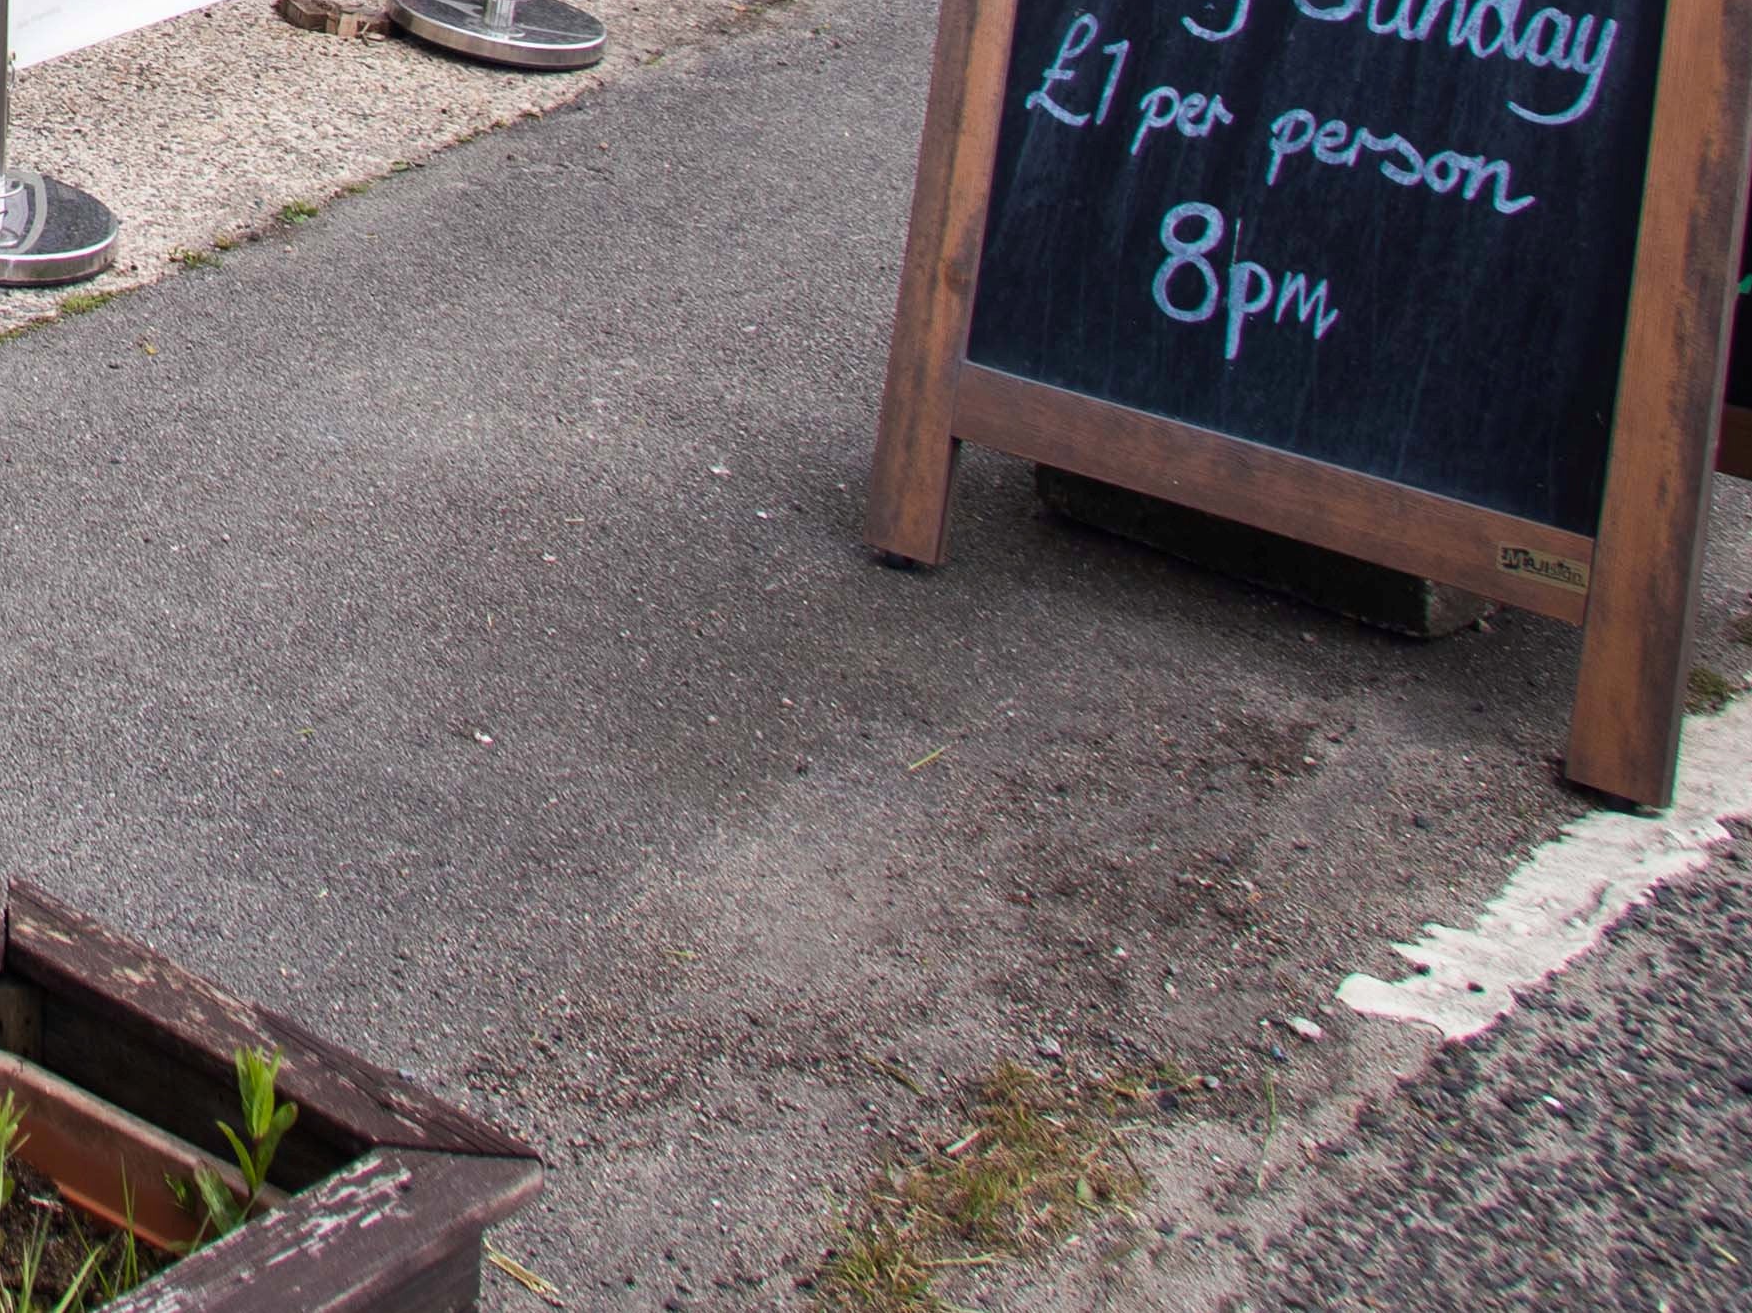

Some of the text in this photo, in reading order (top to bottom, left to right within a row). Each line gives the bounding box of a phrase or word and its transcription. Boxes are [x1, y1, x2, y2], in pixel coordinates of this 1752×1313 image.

[1026, 15, 1536, 216] £1 per person
[1152, 201, 1339, 360] 8pm
